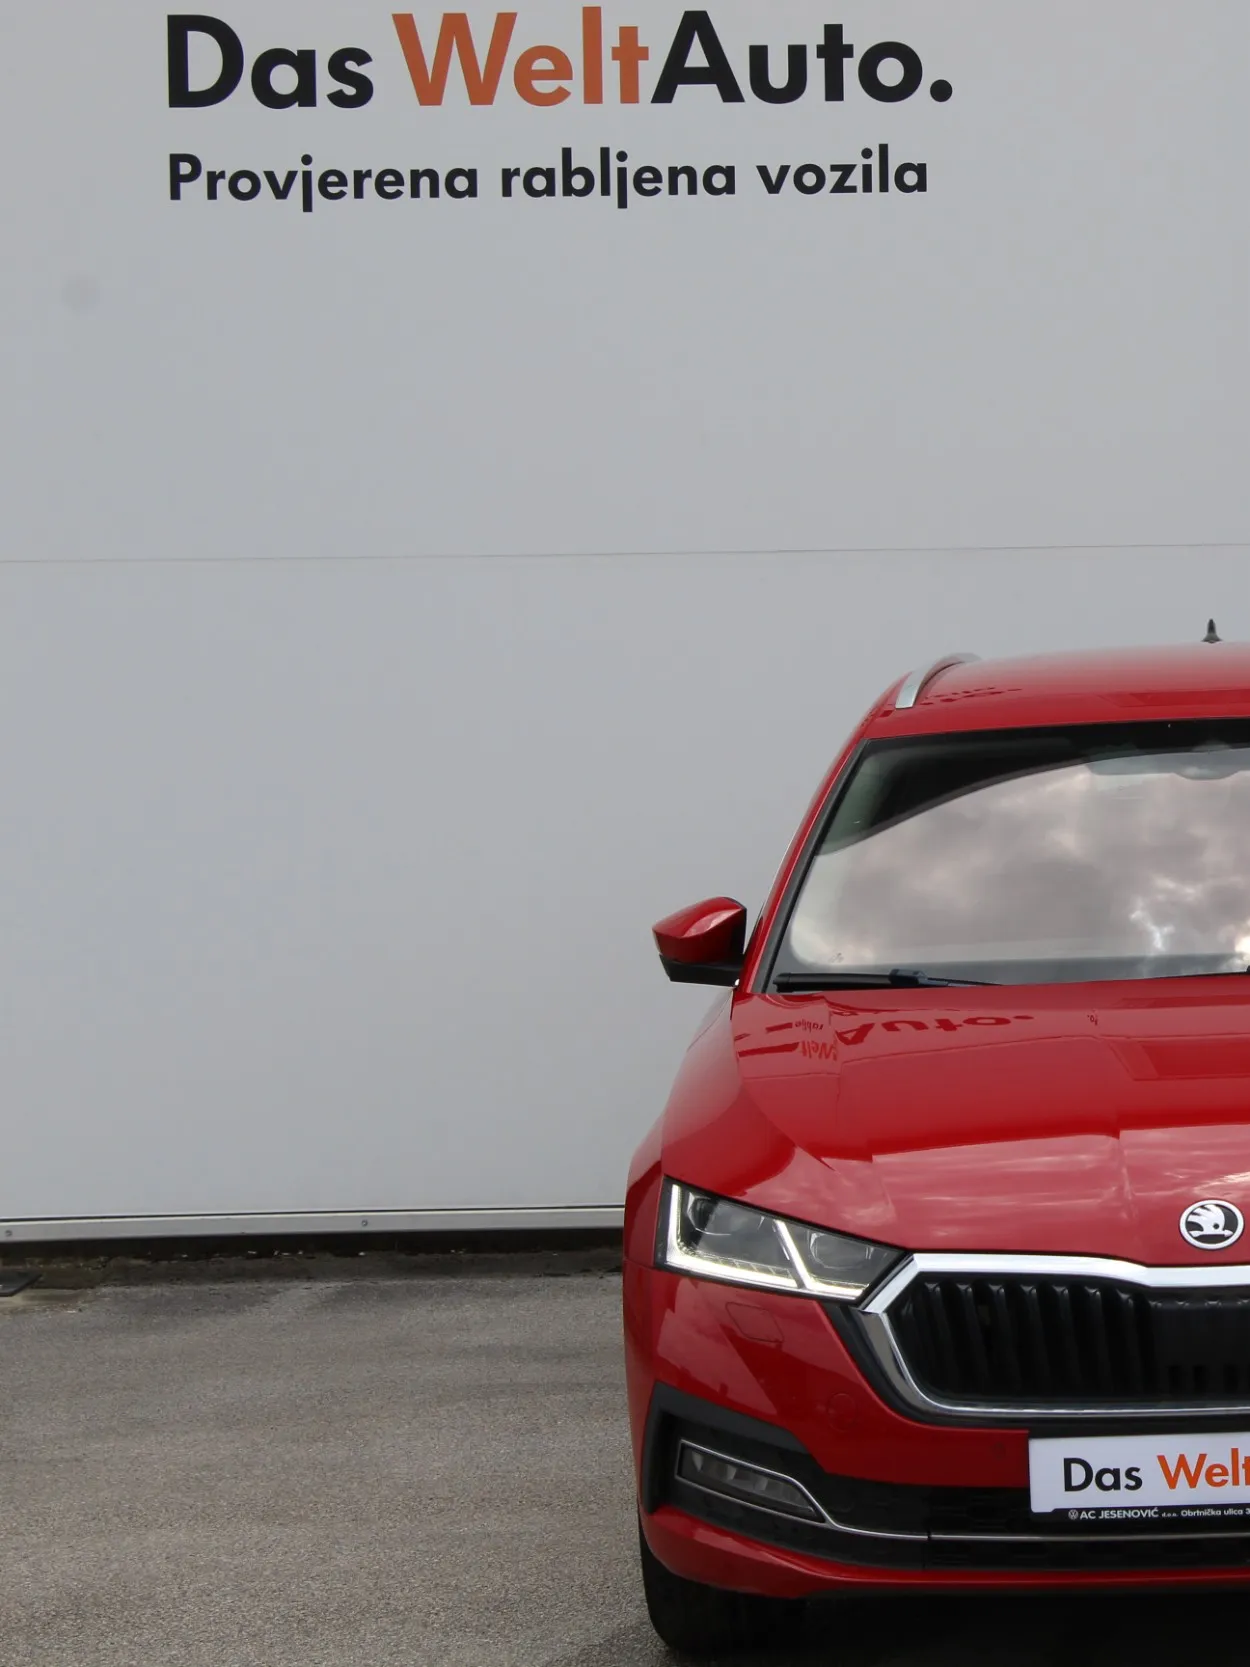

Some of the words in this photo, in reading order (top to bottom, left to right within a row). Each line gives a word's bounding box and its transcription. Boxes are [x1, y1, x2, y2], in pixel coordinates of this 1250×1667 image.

[167, 14, 374, 109] Das
[392, 6, 953, 107] WeltAuto.
[169, 153, 478, 212] Provjerena
[501, 147, 736, 209] rabljena
[756, 144, 928, 195] vozila
[1063, 1457, 1143, 1492] Das
[1080, 1510, 1096, 1520] AC
[1099, 1507, 1159, 1519] JESENOVIĆ
[1181, 1508, 1222, 1517] Obrtnička
[1224, 1507, 1243, 1516] ulica
